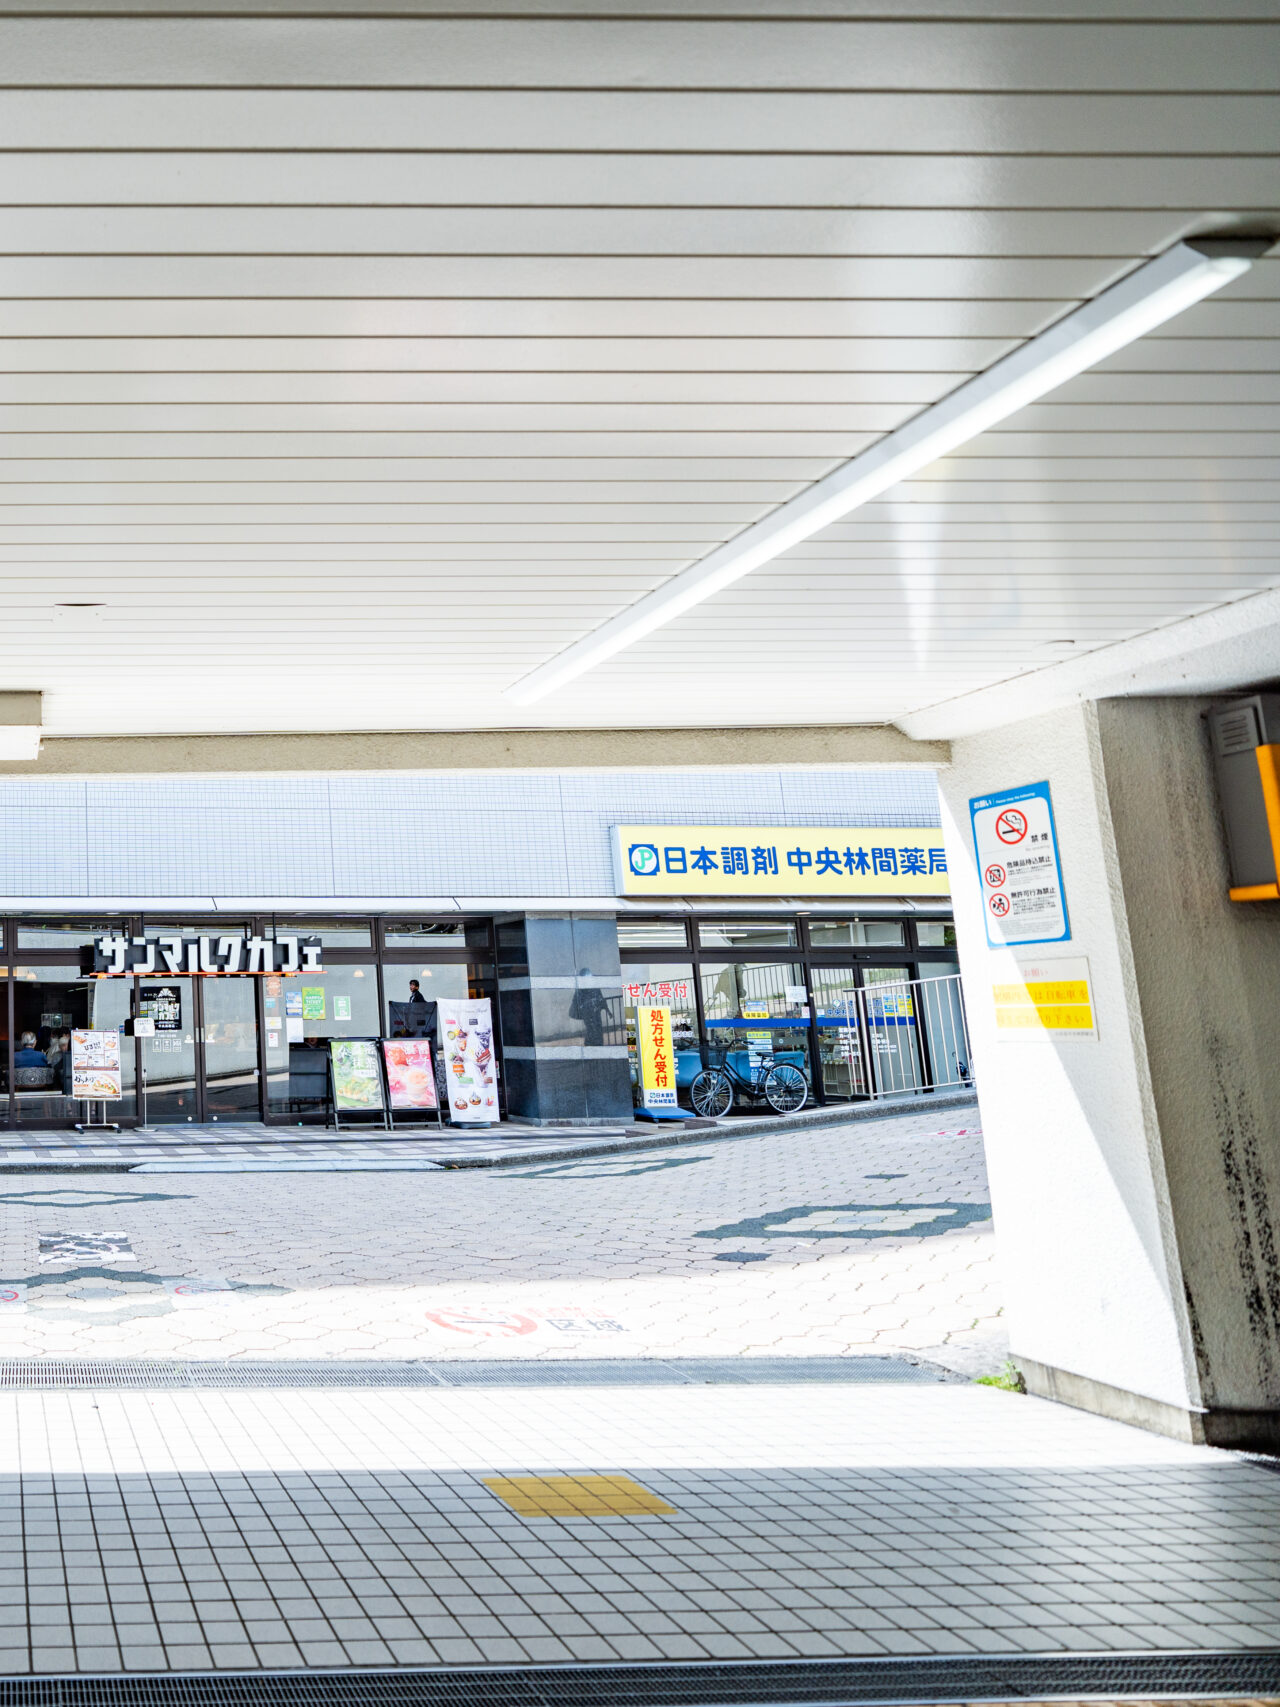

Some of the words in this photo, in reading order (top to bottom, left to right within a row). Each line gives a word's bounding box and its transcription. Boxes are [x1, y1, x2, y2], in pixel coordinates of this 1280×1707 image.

[1031, 833, 1049, 843] 禁煙
[664, 846, 779, 876] 日本調剤
[786, 846, 949, 877] 中央林間薬局
[98, 935, 323, 972] サンマルクカフェ
[622, 983, 688, 999] せん受付
[650, 1009, 668, 1088] 処方せん受付
